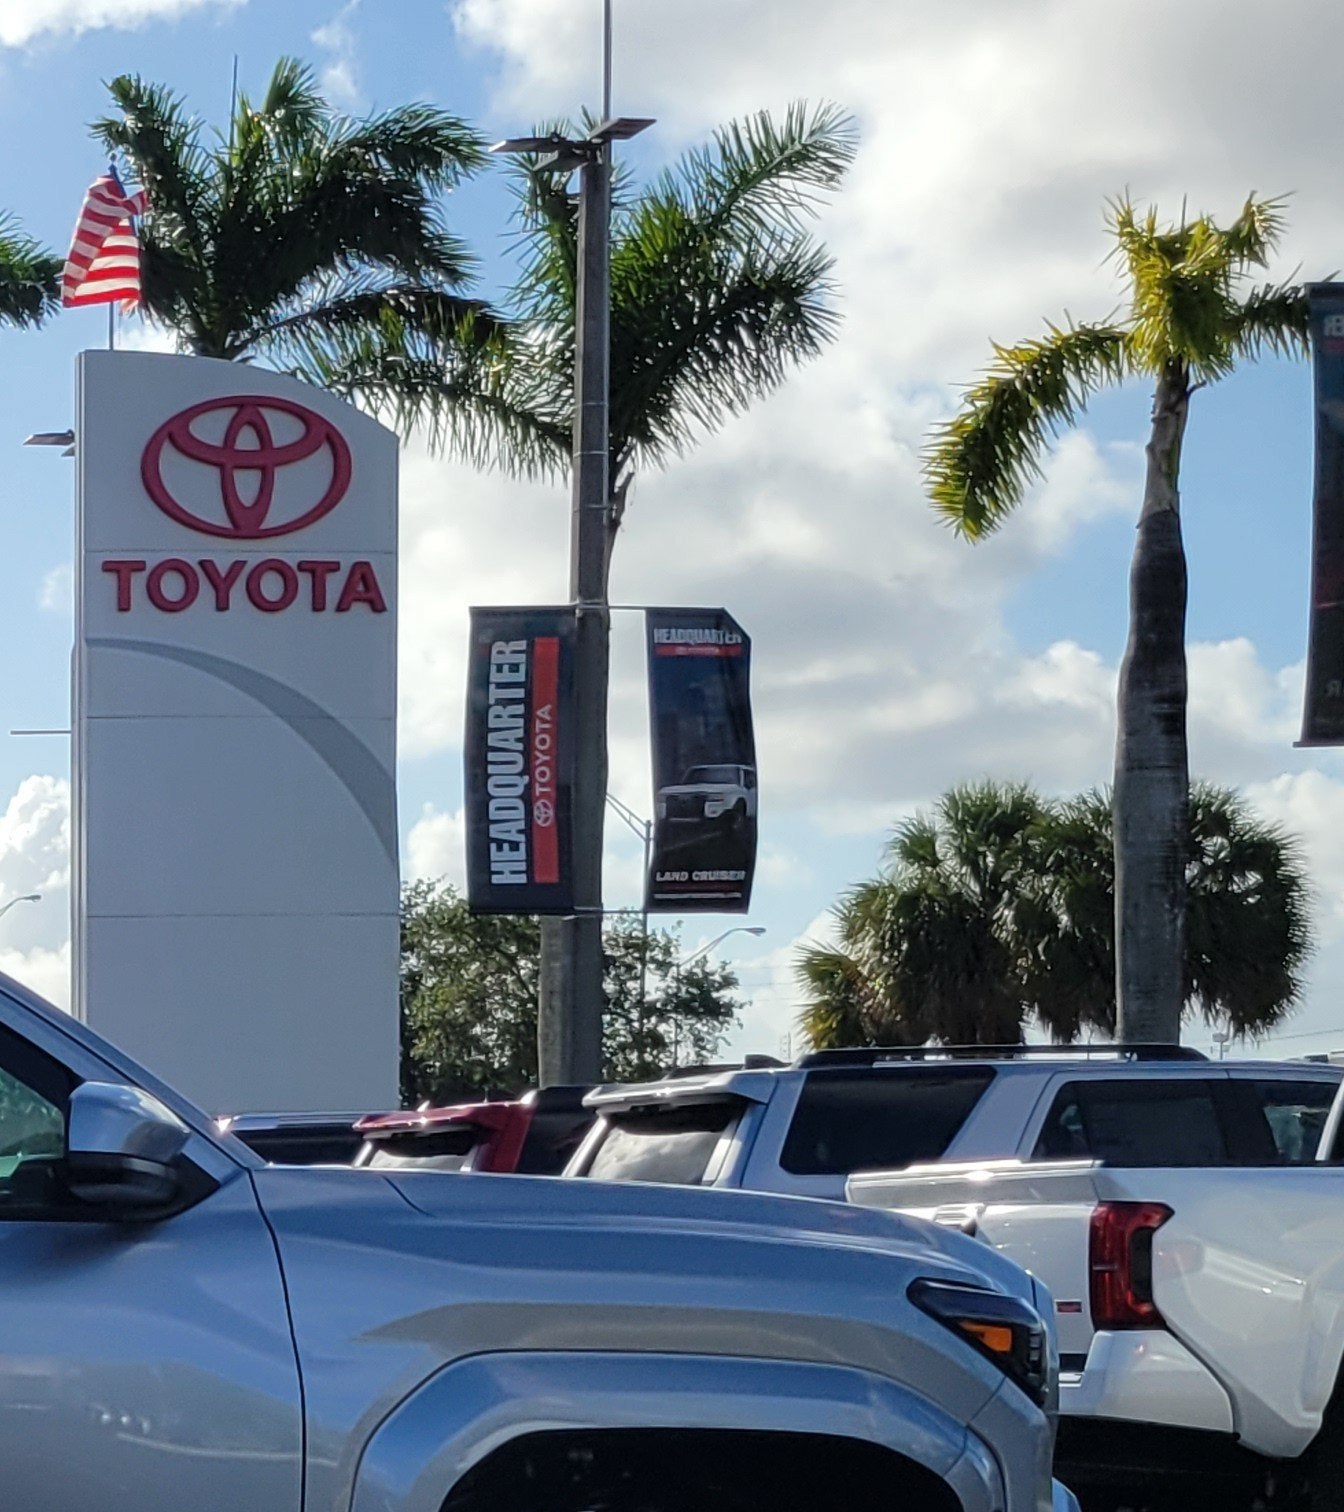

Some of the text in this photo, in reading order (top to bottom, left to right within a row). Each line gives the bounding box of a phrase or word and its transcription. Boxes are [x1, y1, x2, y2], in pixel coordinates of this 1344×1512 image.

[102, 558, 388, 613] TOYOTA
[654, 628, 742, 645] HEADQUARTER
[486, 639, 530, 884] HEADQUARTER
[535, 704, 553, 795] TOYOTA
[656, 871, 689, 882] LAND
